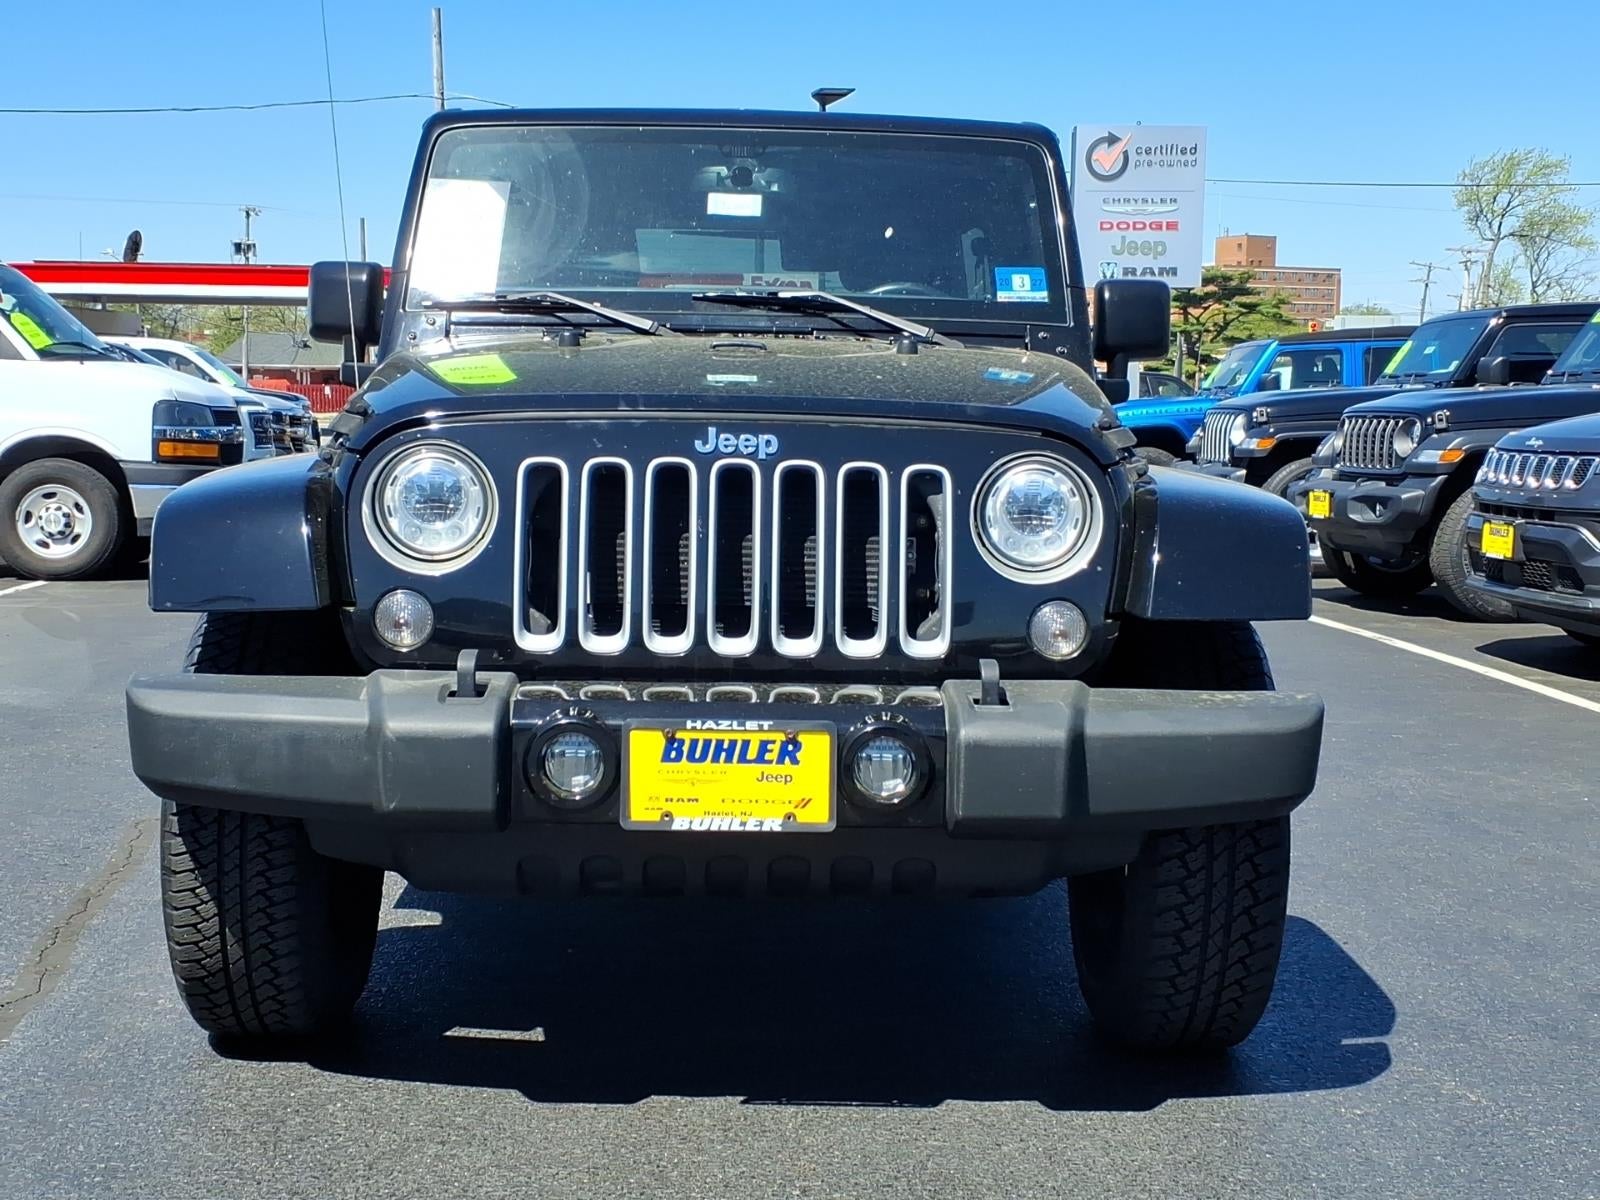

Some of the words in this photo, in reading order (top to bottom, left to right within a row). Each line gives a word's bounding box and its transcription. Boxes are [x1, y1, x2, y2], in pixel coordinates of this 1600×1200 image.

[1135, 143, 1198, 156] certified
[1134, 158, 1198, 170] pre-owned
[1102, 197, 1179, 205] CHRYSLER
[1099, 220, 1180, 232] DODGE
[1111, 235, 1168, 260] Jeep
[1121, 266, 1178, 277] RAM
[1018, 276, 1026, 289] 3
[694, 426, 779, 460] Jeep
[685, 719, 775, 731] HAZLET
[660, 737, 803, 766] BUHLER
[755, 771, 794, 785] Jeep
[664, 796, 700, 804] RAM
[670, 816, 784, 832] BUHLER
